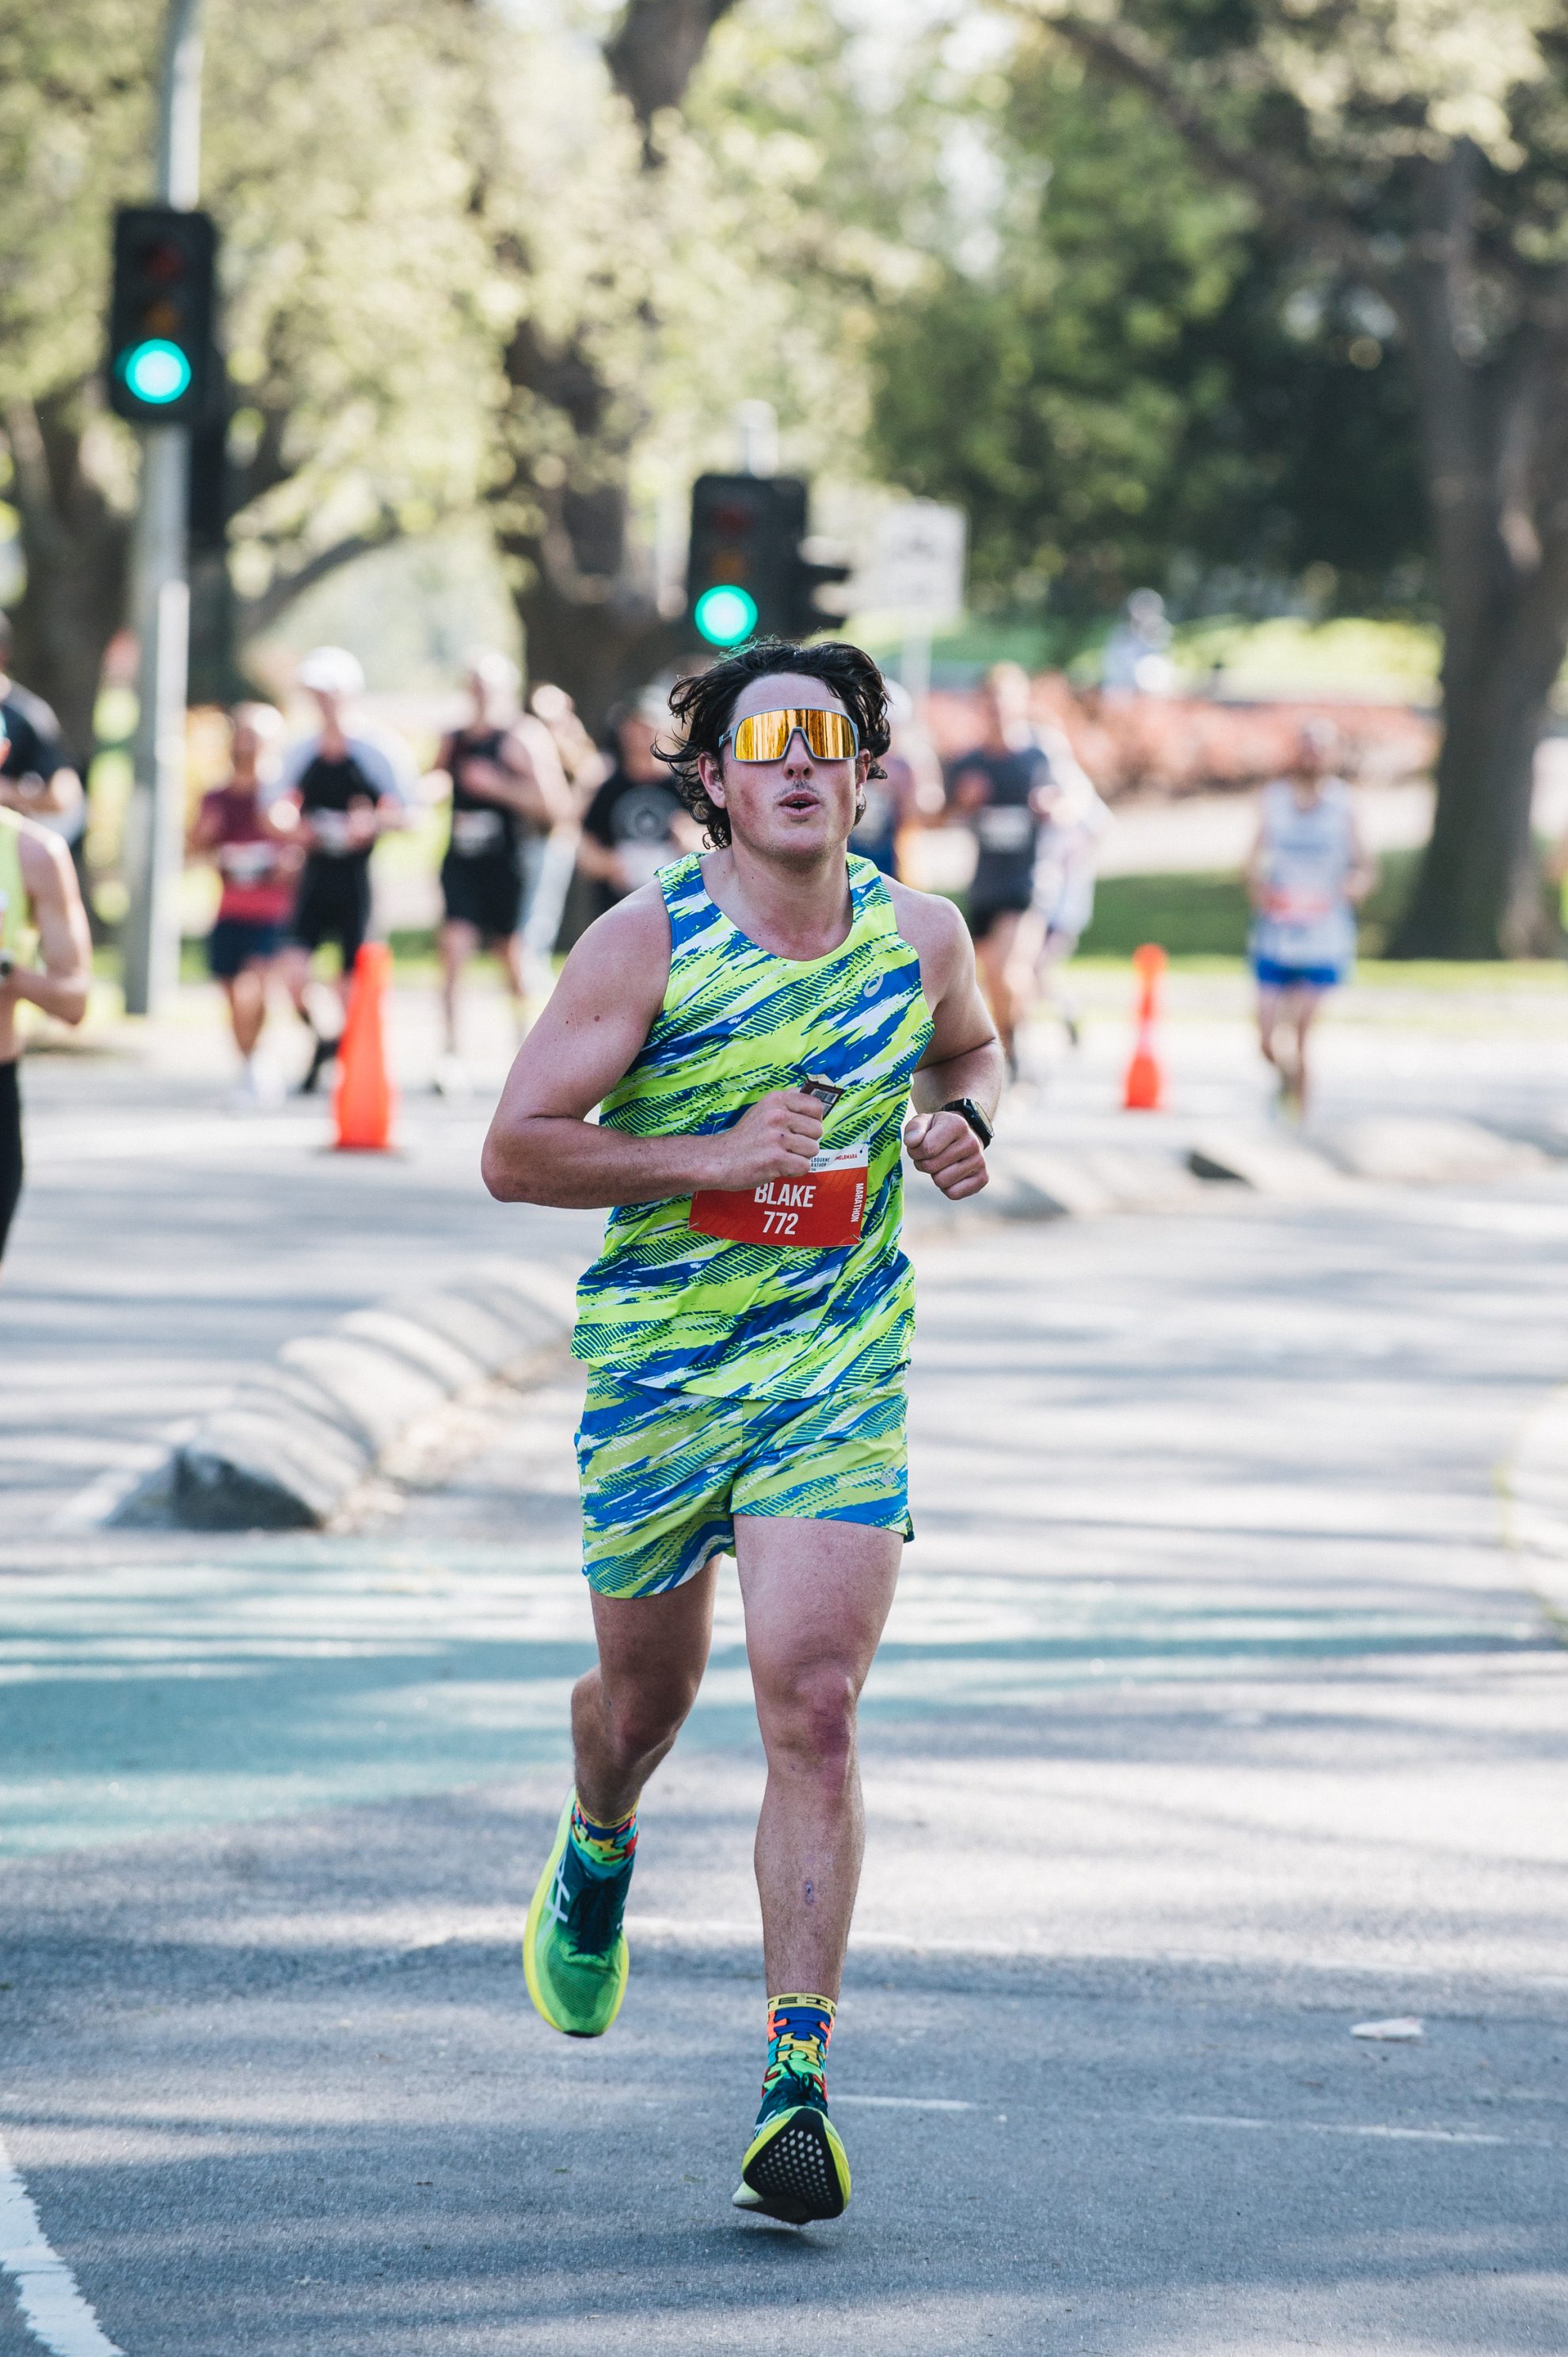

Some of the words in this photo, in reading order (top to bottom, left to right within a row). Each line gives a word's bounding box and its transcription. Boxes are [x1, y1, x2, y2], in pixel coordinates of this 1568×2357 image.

[754, 1182, 816, 1208] BLAKE
[850, 1182, 864, 1222] MARATHON
[762, 1210, 799, 1235] 772
